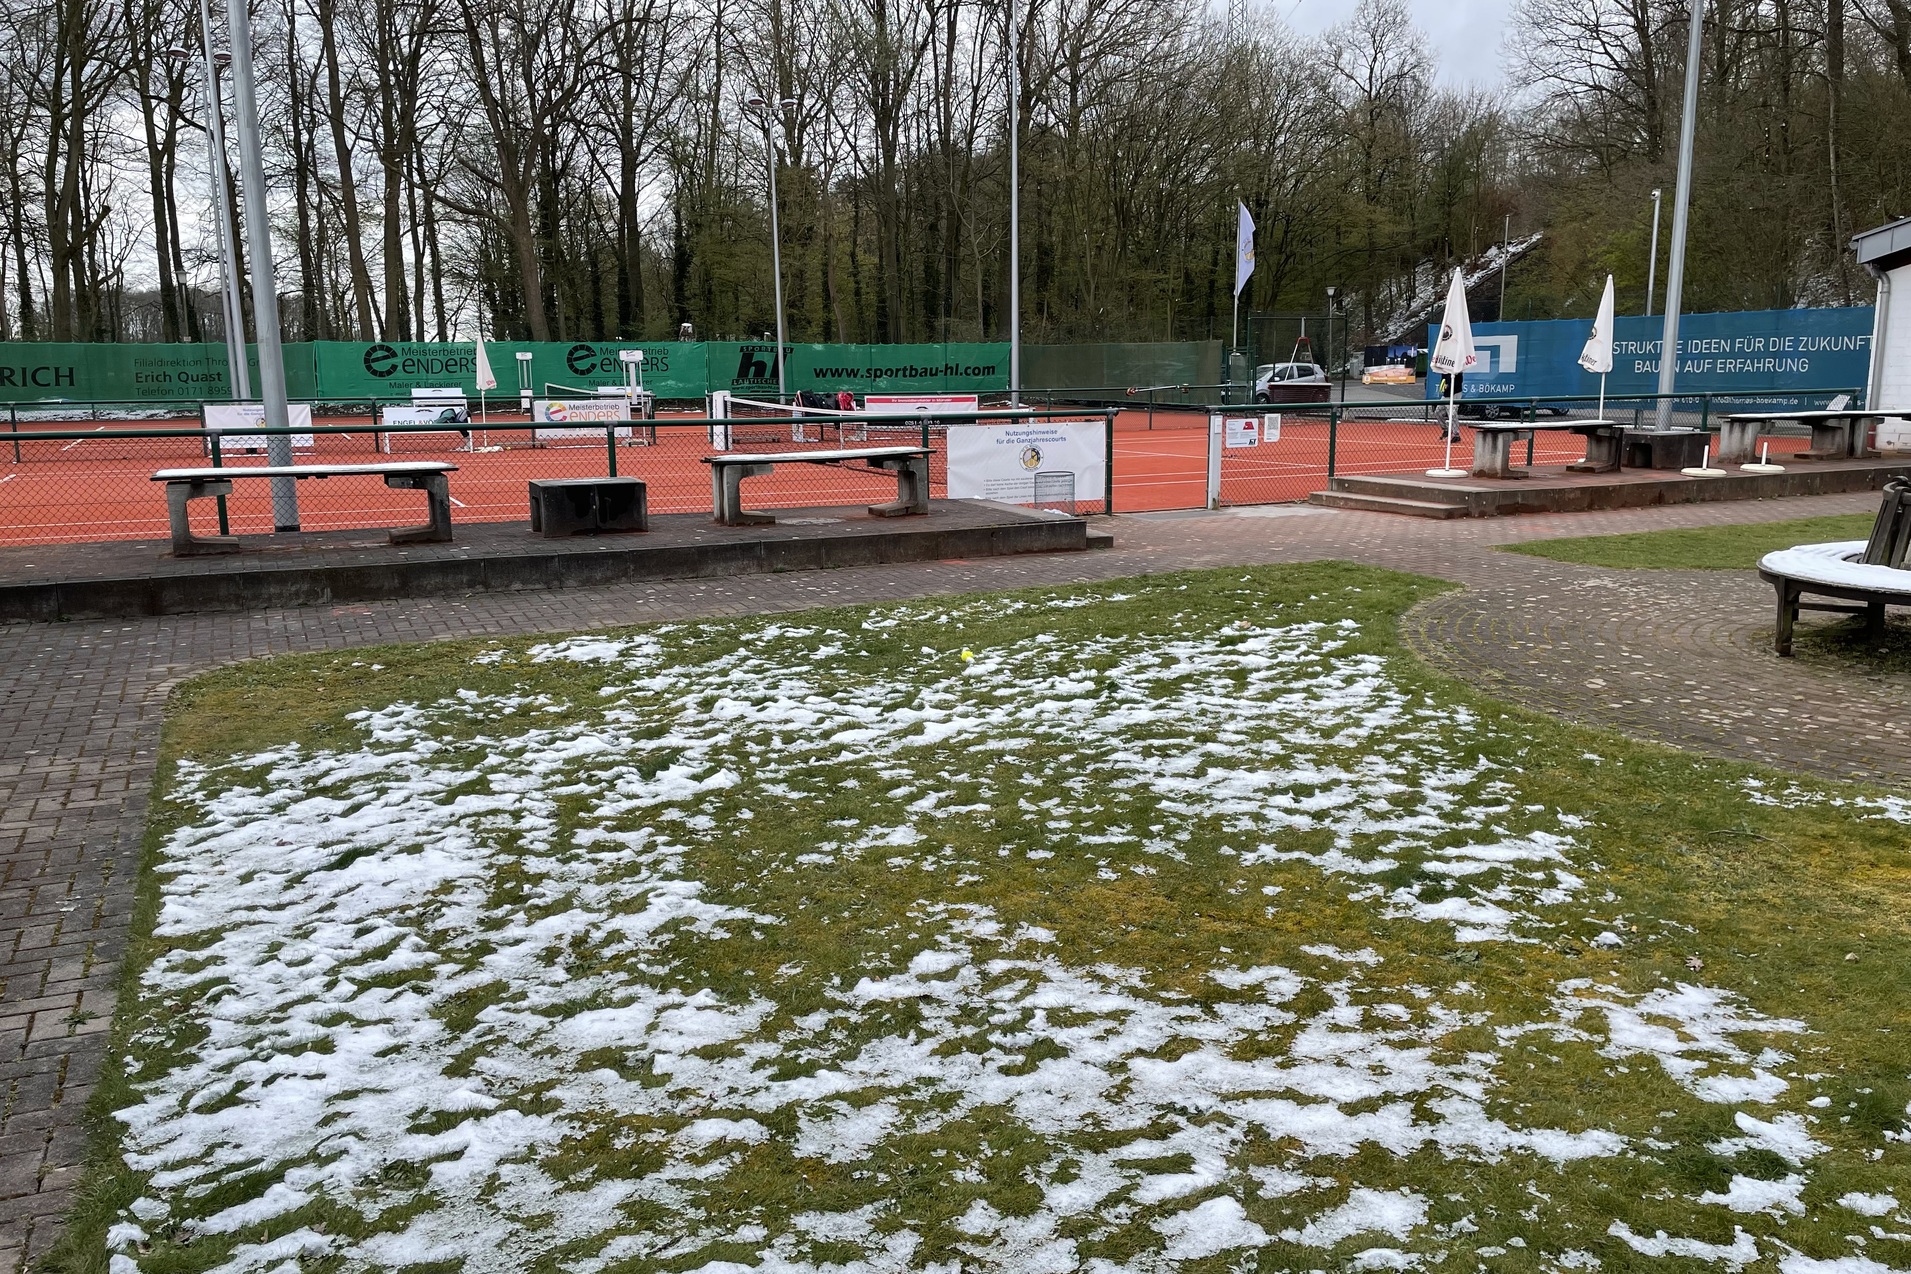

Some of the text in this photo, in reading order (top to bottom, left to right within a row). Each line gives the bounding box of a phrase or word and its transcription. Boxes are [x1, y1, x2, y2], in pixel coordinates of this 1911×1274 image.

[1613, 335, 1874, 354] STRUKTE IDEEN FÜR DIE ZUKUNFT
[134, 358, 201, 368] Filialdirektion
[1634, 358, 1809, 373] BAUN AUF ERFAHRUNG
[0, 366, 76, 388] RICH
[135, 371, 223, 384] Erich Quast
[813, 363, 996, 382] www.sportbau-hl.com
[389, 381, 413, 389] Maler
[415, 381, 421, 389] &
[1471, 384, 1477, 393] &
[1478, 382, 1516, 393] BÖKAMP
[135, 387, 175, 396] Telefon
[177, 387, 204, 396] 0171
[568, 403, 620, 411] Meisterbetrieb
[1005, 429, 1058, 438] Nutzungshinweise
[1016, 436, 1067, 445] Ganzjahrescourts
